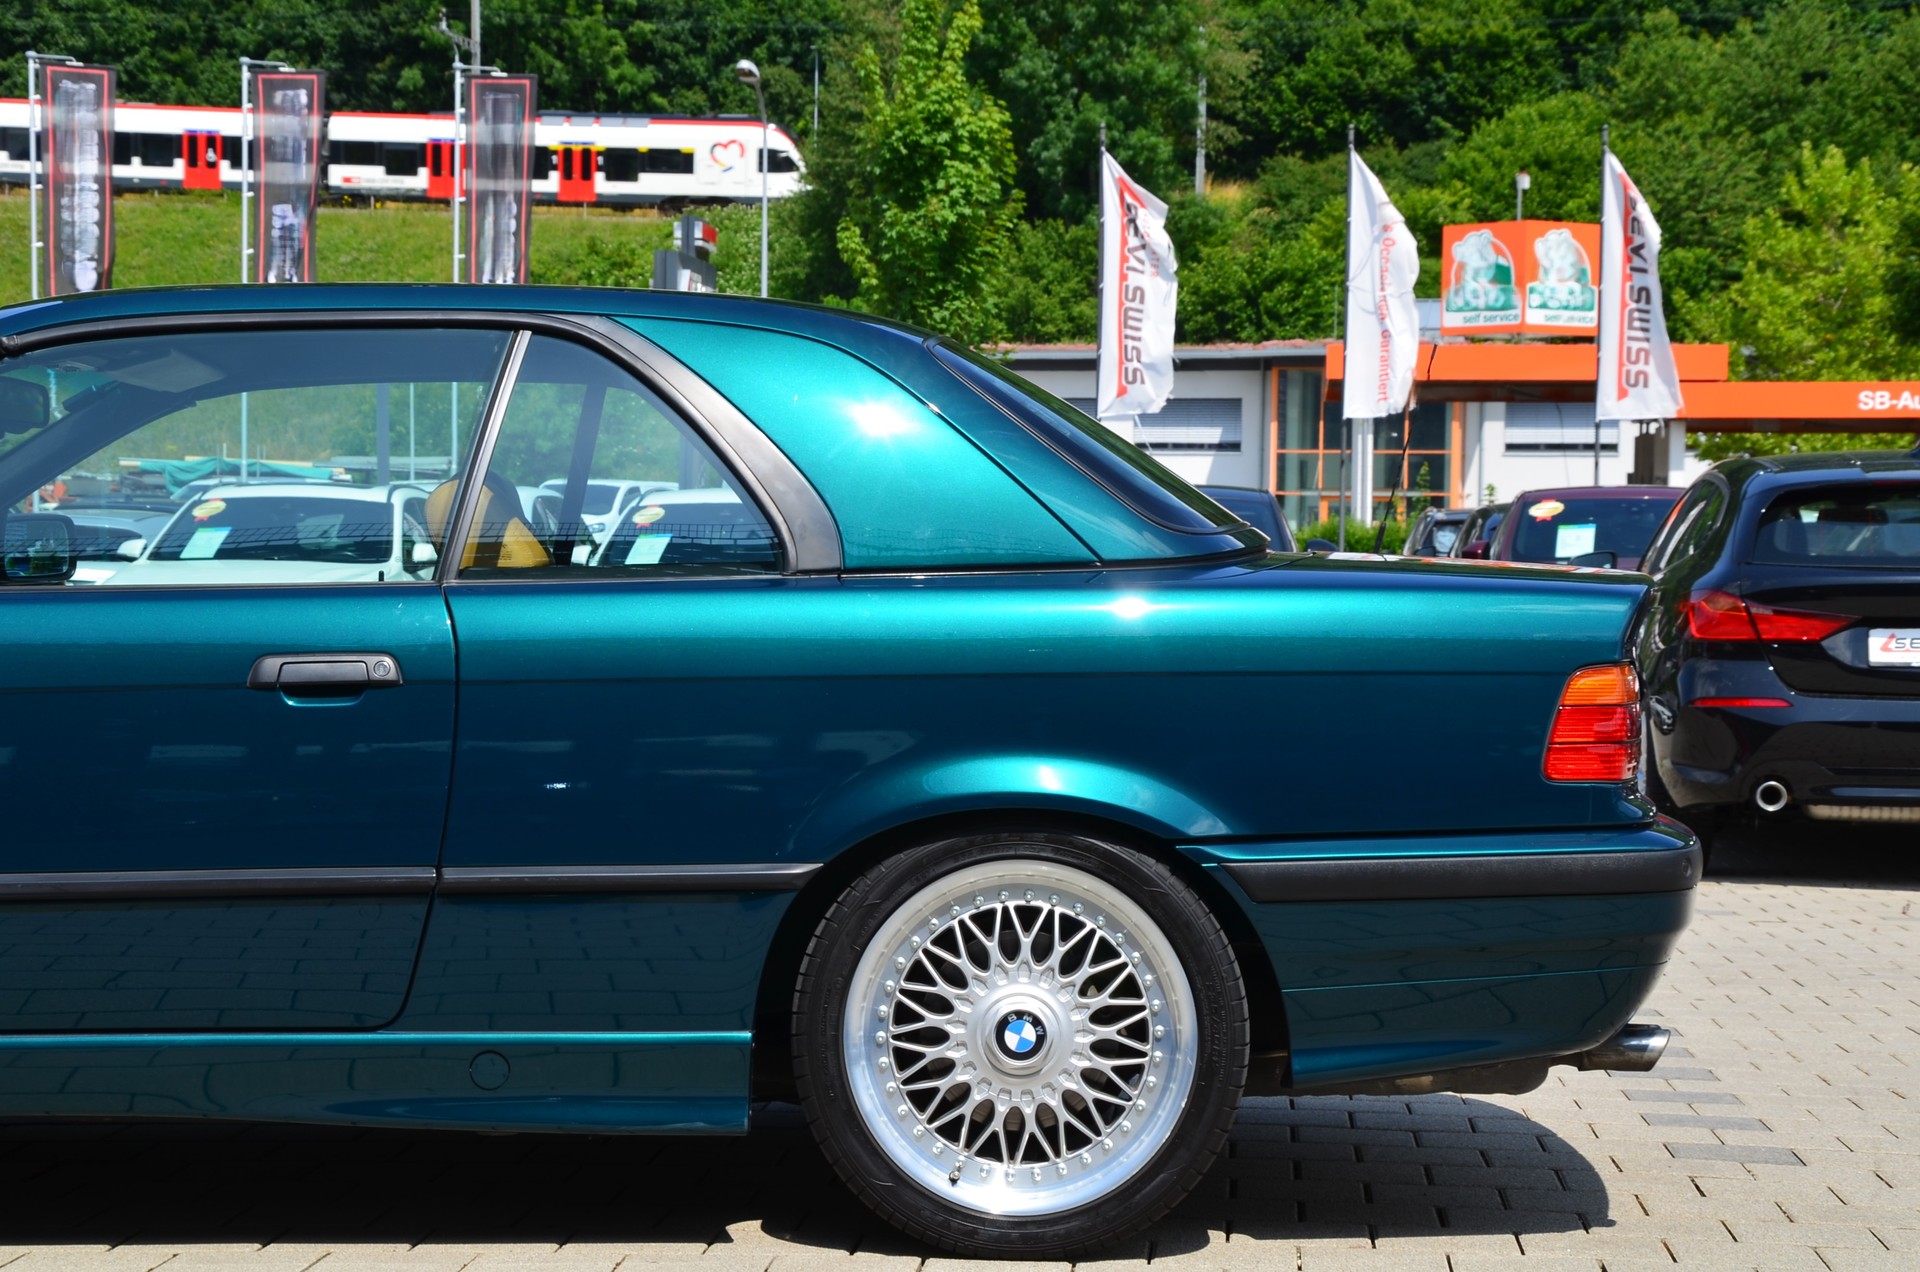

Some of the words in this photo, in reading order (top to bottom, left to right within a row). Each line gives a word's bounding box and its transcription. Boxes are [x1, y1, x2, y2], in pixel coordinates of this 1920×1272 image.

[1122, 283, 1146, 386] SWISS
[1463, 313, 1481, 324] self
[1483, 313, 1520, 323] service
[1624, 284, 1652, 389] SWISS
[1007, 1012, 1044, 1035] BMW
